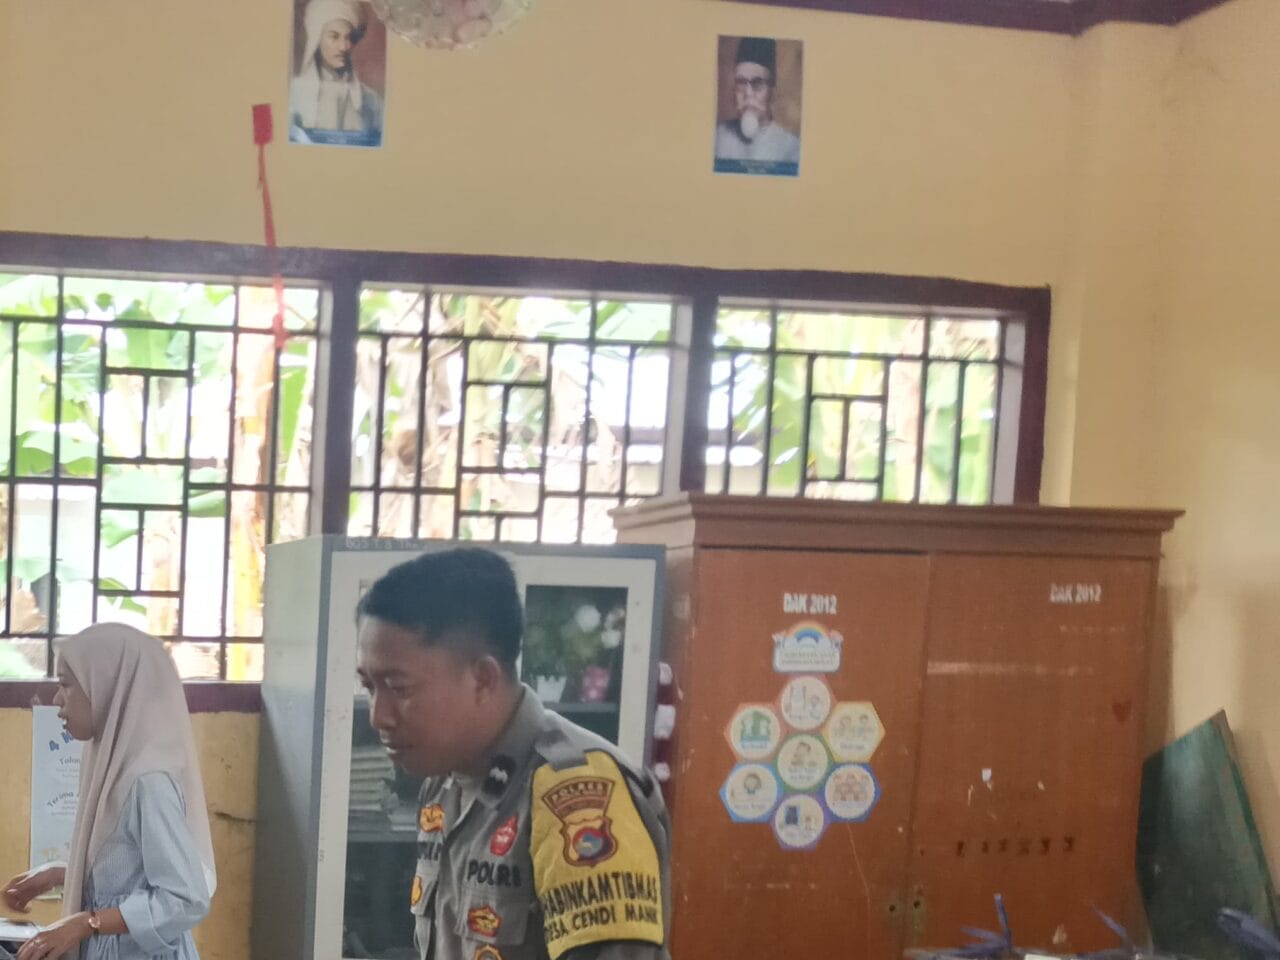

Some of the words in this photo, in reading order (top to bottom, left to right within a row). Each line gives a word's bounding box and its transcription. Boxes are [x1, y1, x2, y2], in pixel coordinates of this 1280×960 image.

[783, 592, 808, 614] DAK
[809, 593, 837, 615] 2012
[1075, 583, 1102, 604] 2012
[551, 781, 604, 801] POLRES
[572, 904, 616, 930] CENDI
